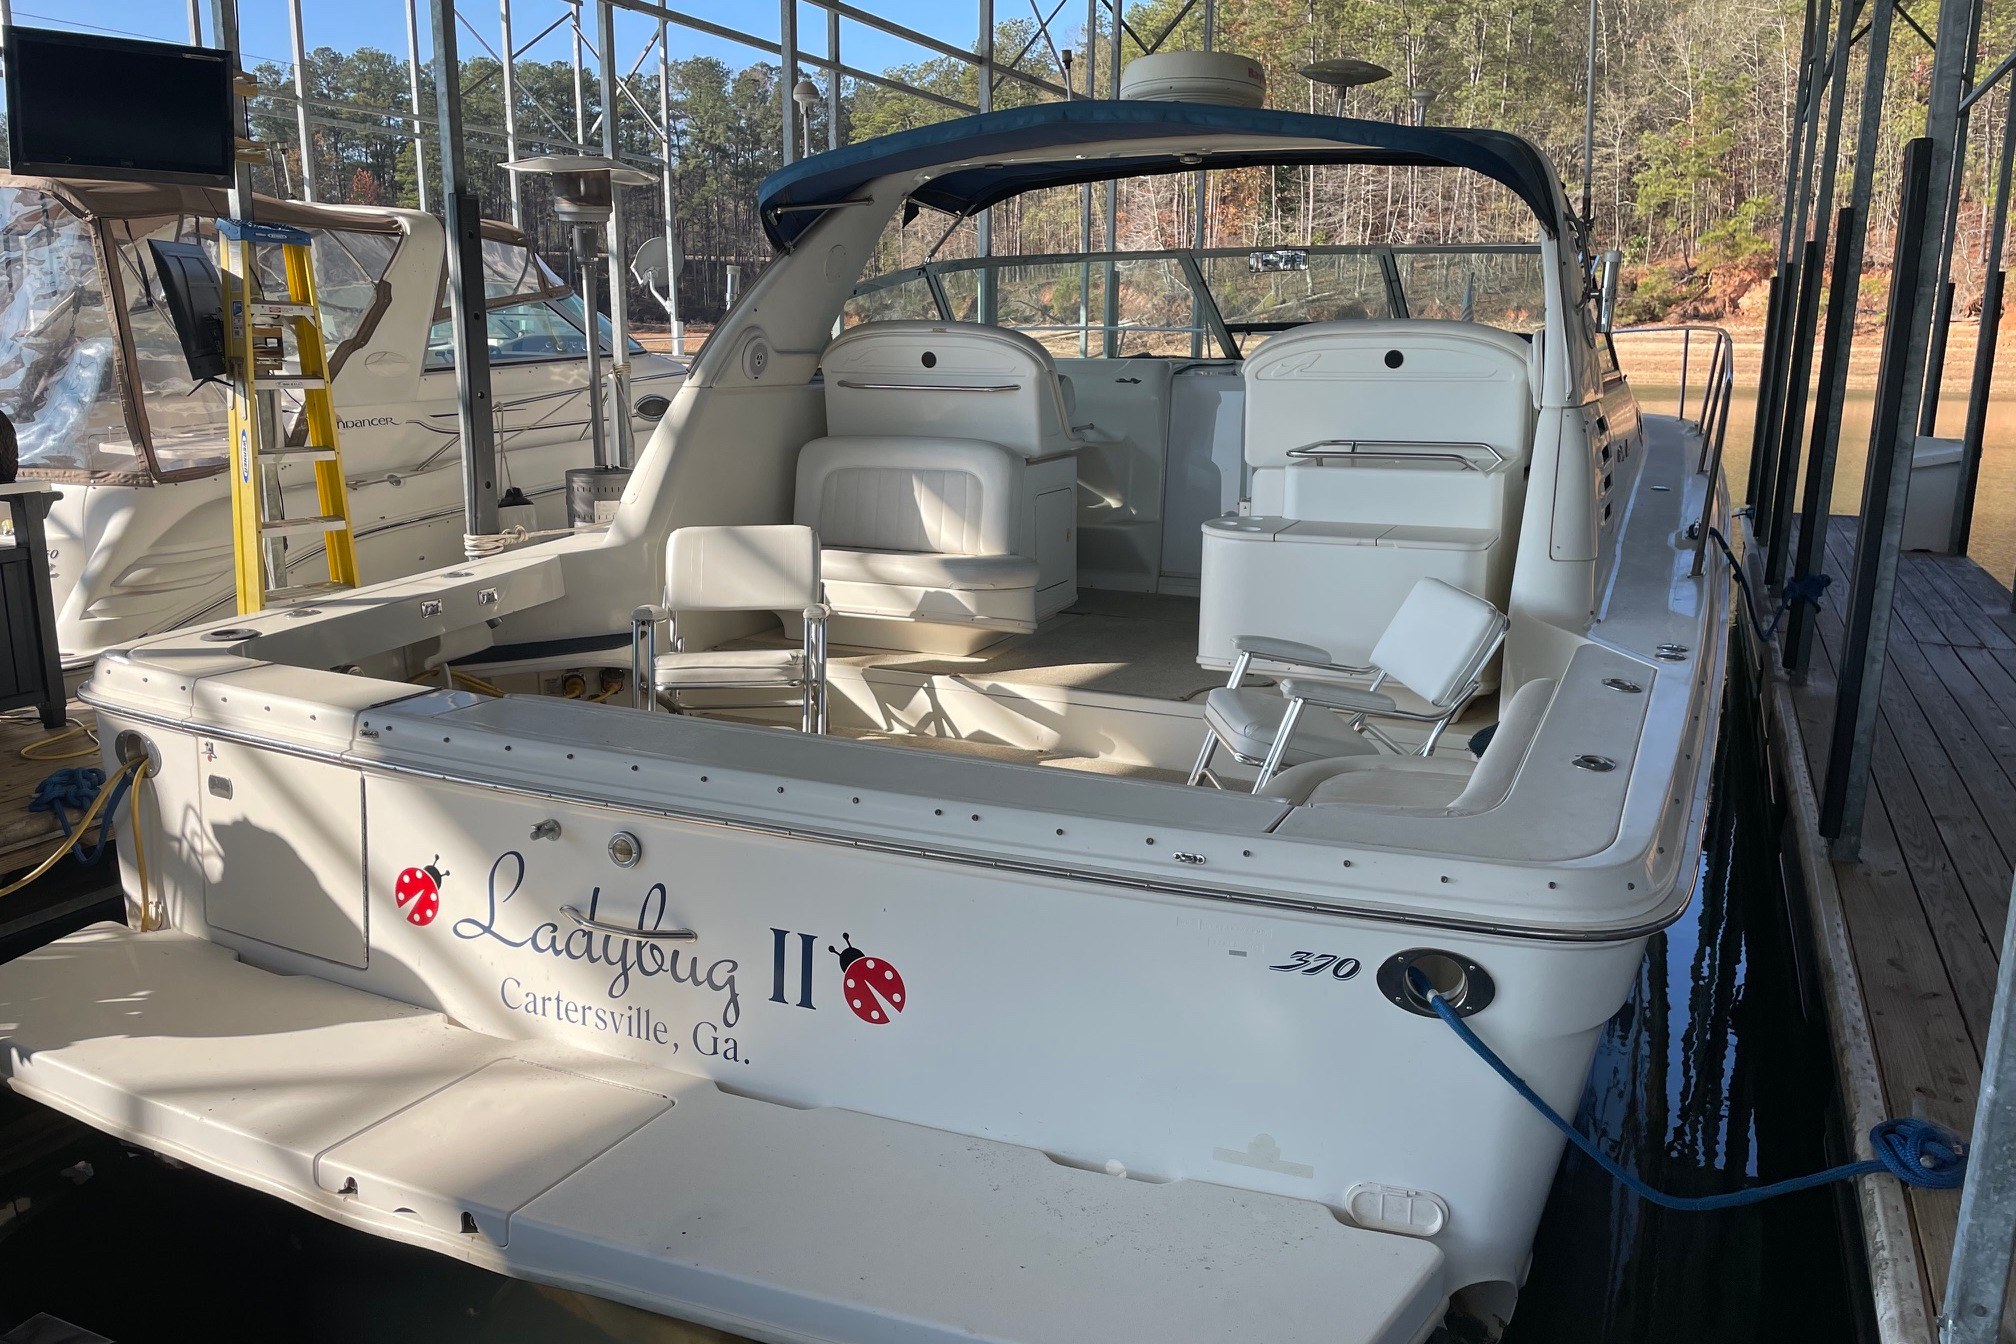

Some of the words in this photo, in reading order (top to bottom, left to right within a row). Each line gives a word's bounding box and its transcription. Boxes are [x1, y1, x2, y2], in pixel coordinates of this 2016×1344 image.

[452, 850, 742, 1028] Ladybug
[768, 927, 818, 1010] II
[1269, 950, 1362, 981] 370
[500, 977, 680, 1053] Cartersville,
[692, 1021, 751, 1065] Ga.
